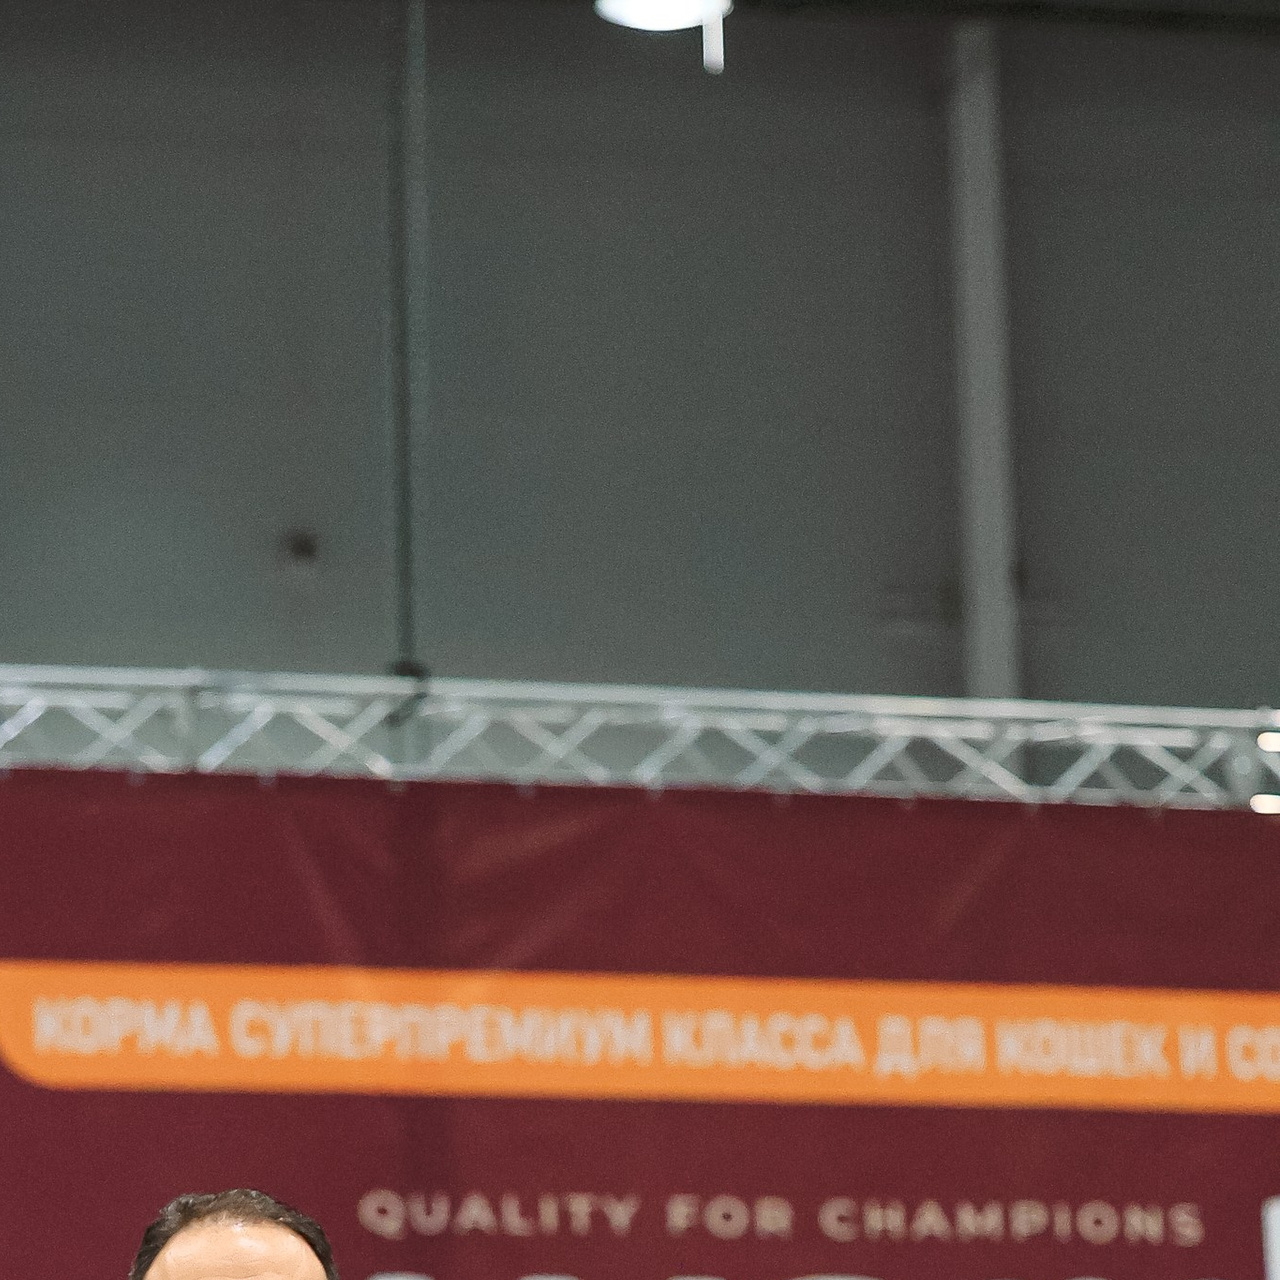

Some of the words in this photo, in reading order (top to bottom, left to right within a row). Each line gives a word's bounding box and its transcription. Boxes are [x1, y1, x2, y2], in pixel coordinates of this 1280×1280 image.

[32, 996, 218, 1055] КОРМА
[228, 997, 652, 1066] СУПЕРПРЕМИУМ
[661, 1009, 866, 1072] КЛАССА
[874, 1014, 986, 1081] ДЛЯ
[995, 1016, 1170, 1079] КОШЕК
[1178, 1021, 1217, 1080] И
[356, 1188, 641, 1242] QUALITY
[665, 1192, 796, 1241] FOR
[817, 1196, 1206, 1247] CHAMPIONS
